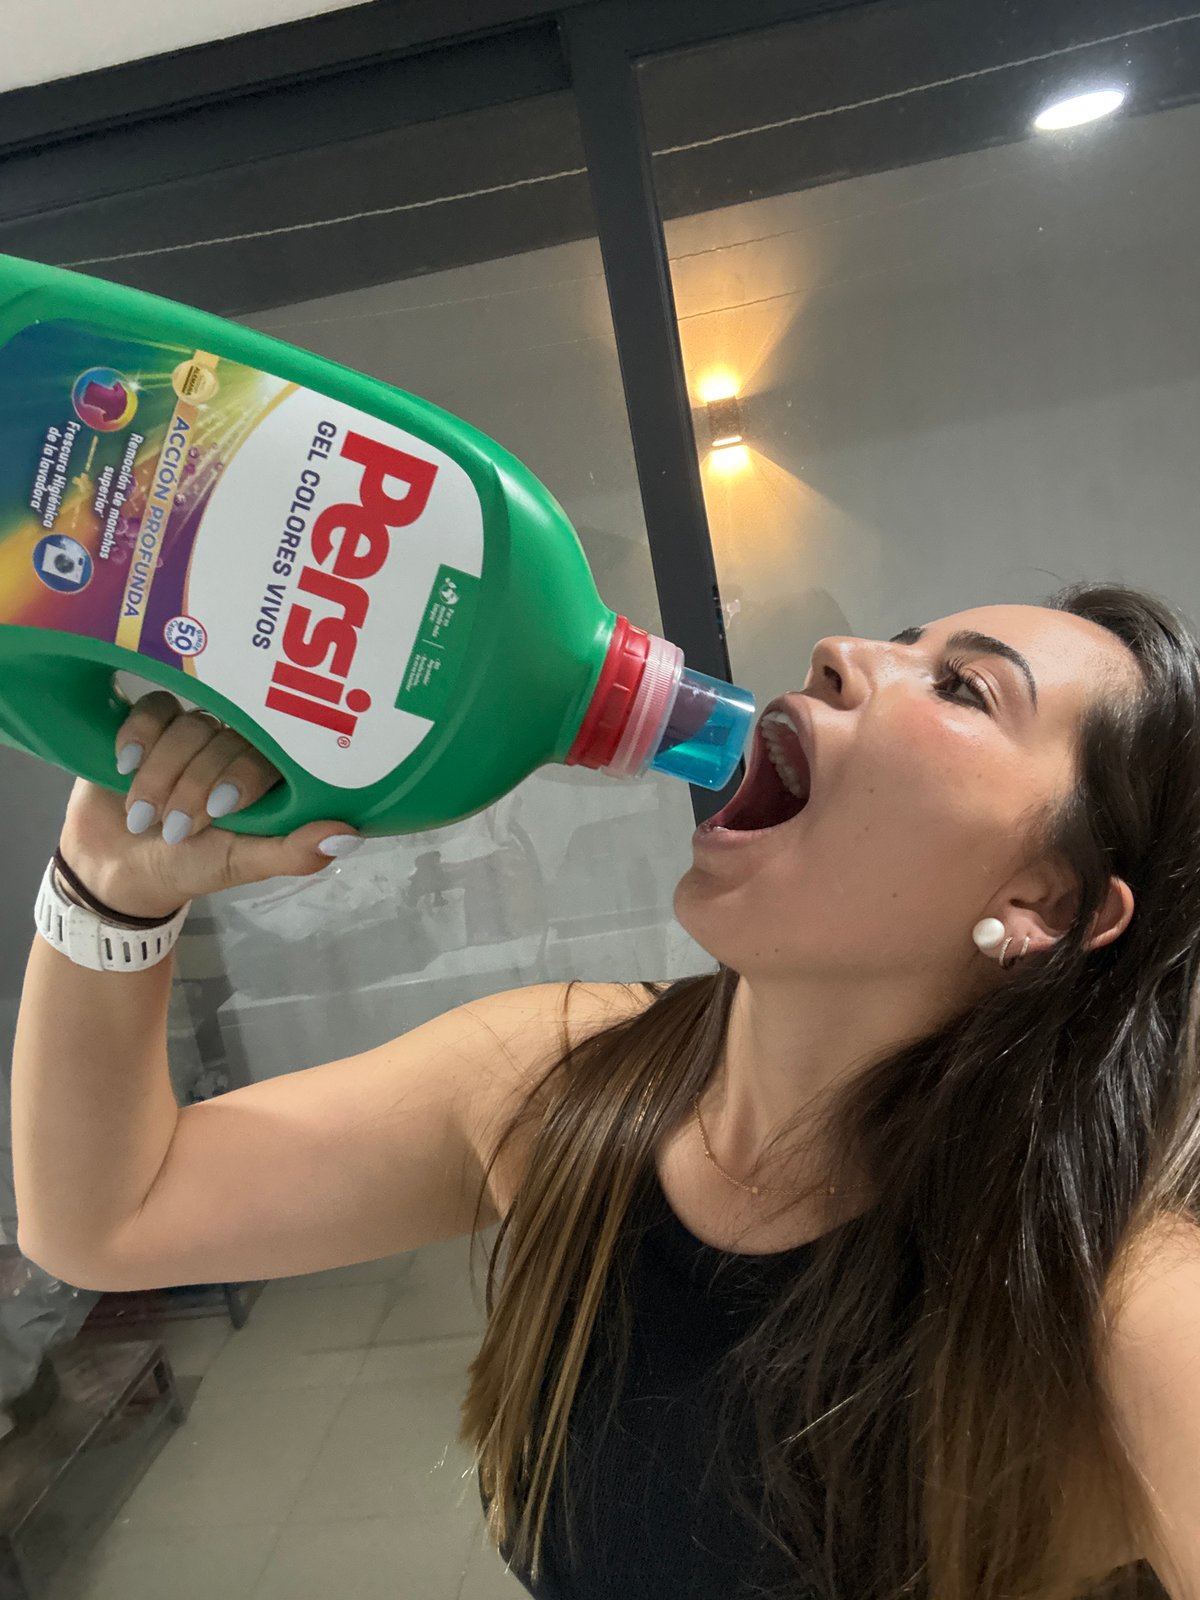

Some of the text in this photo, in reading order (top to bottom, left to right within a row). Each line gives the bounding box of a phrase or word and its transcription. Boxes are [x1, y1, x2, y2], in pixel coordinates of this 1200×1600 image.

[43, 443, 58, 456] la
[43, 421, 81, 528] Frescura Higiénica
[47, 427, 62, 443] de
[100, 433, 144, 560] Remoción de manchas
[124, 416, 190, 617] ACCIÓN PROFUNDA
[252, 420, 337, 650] GEL COLORES VIVOS
[174, 621, 196, 650] 50
[265, 430, 439, 737] Persil
